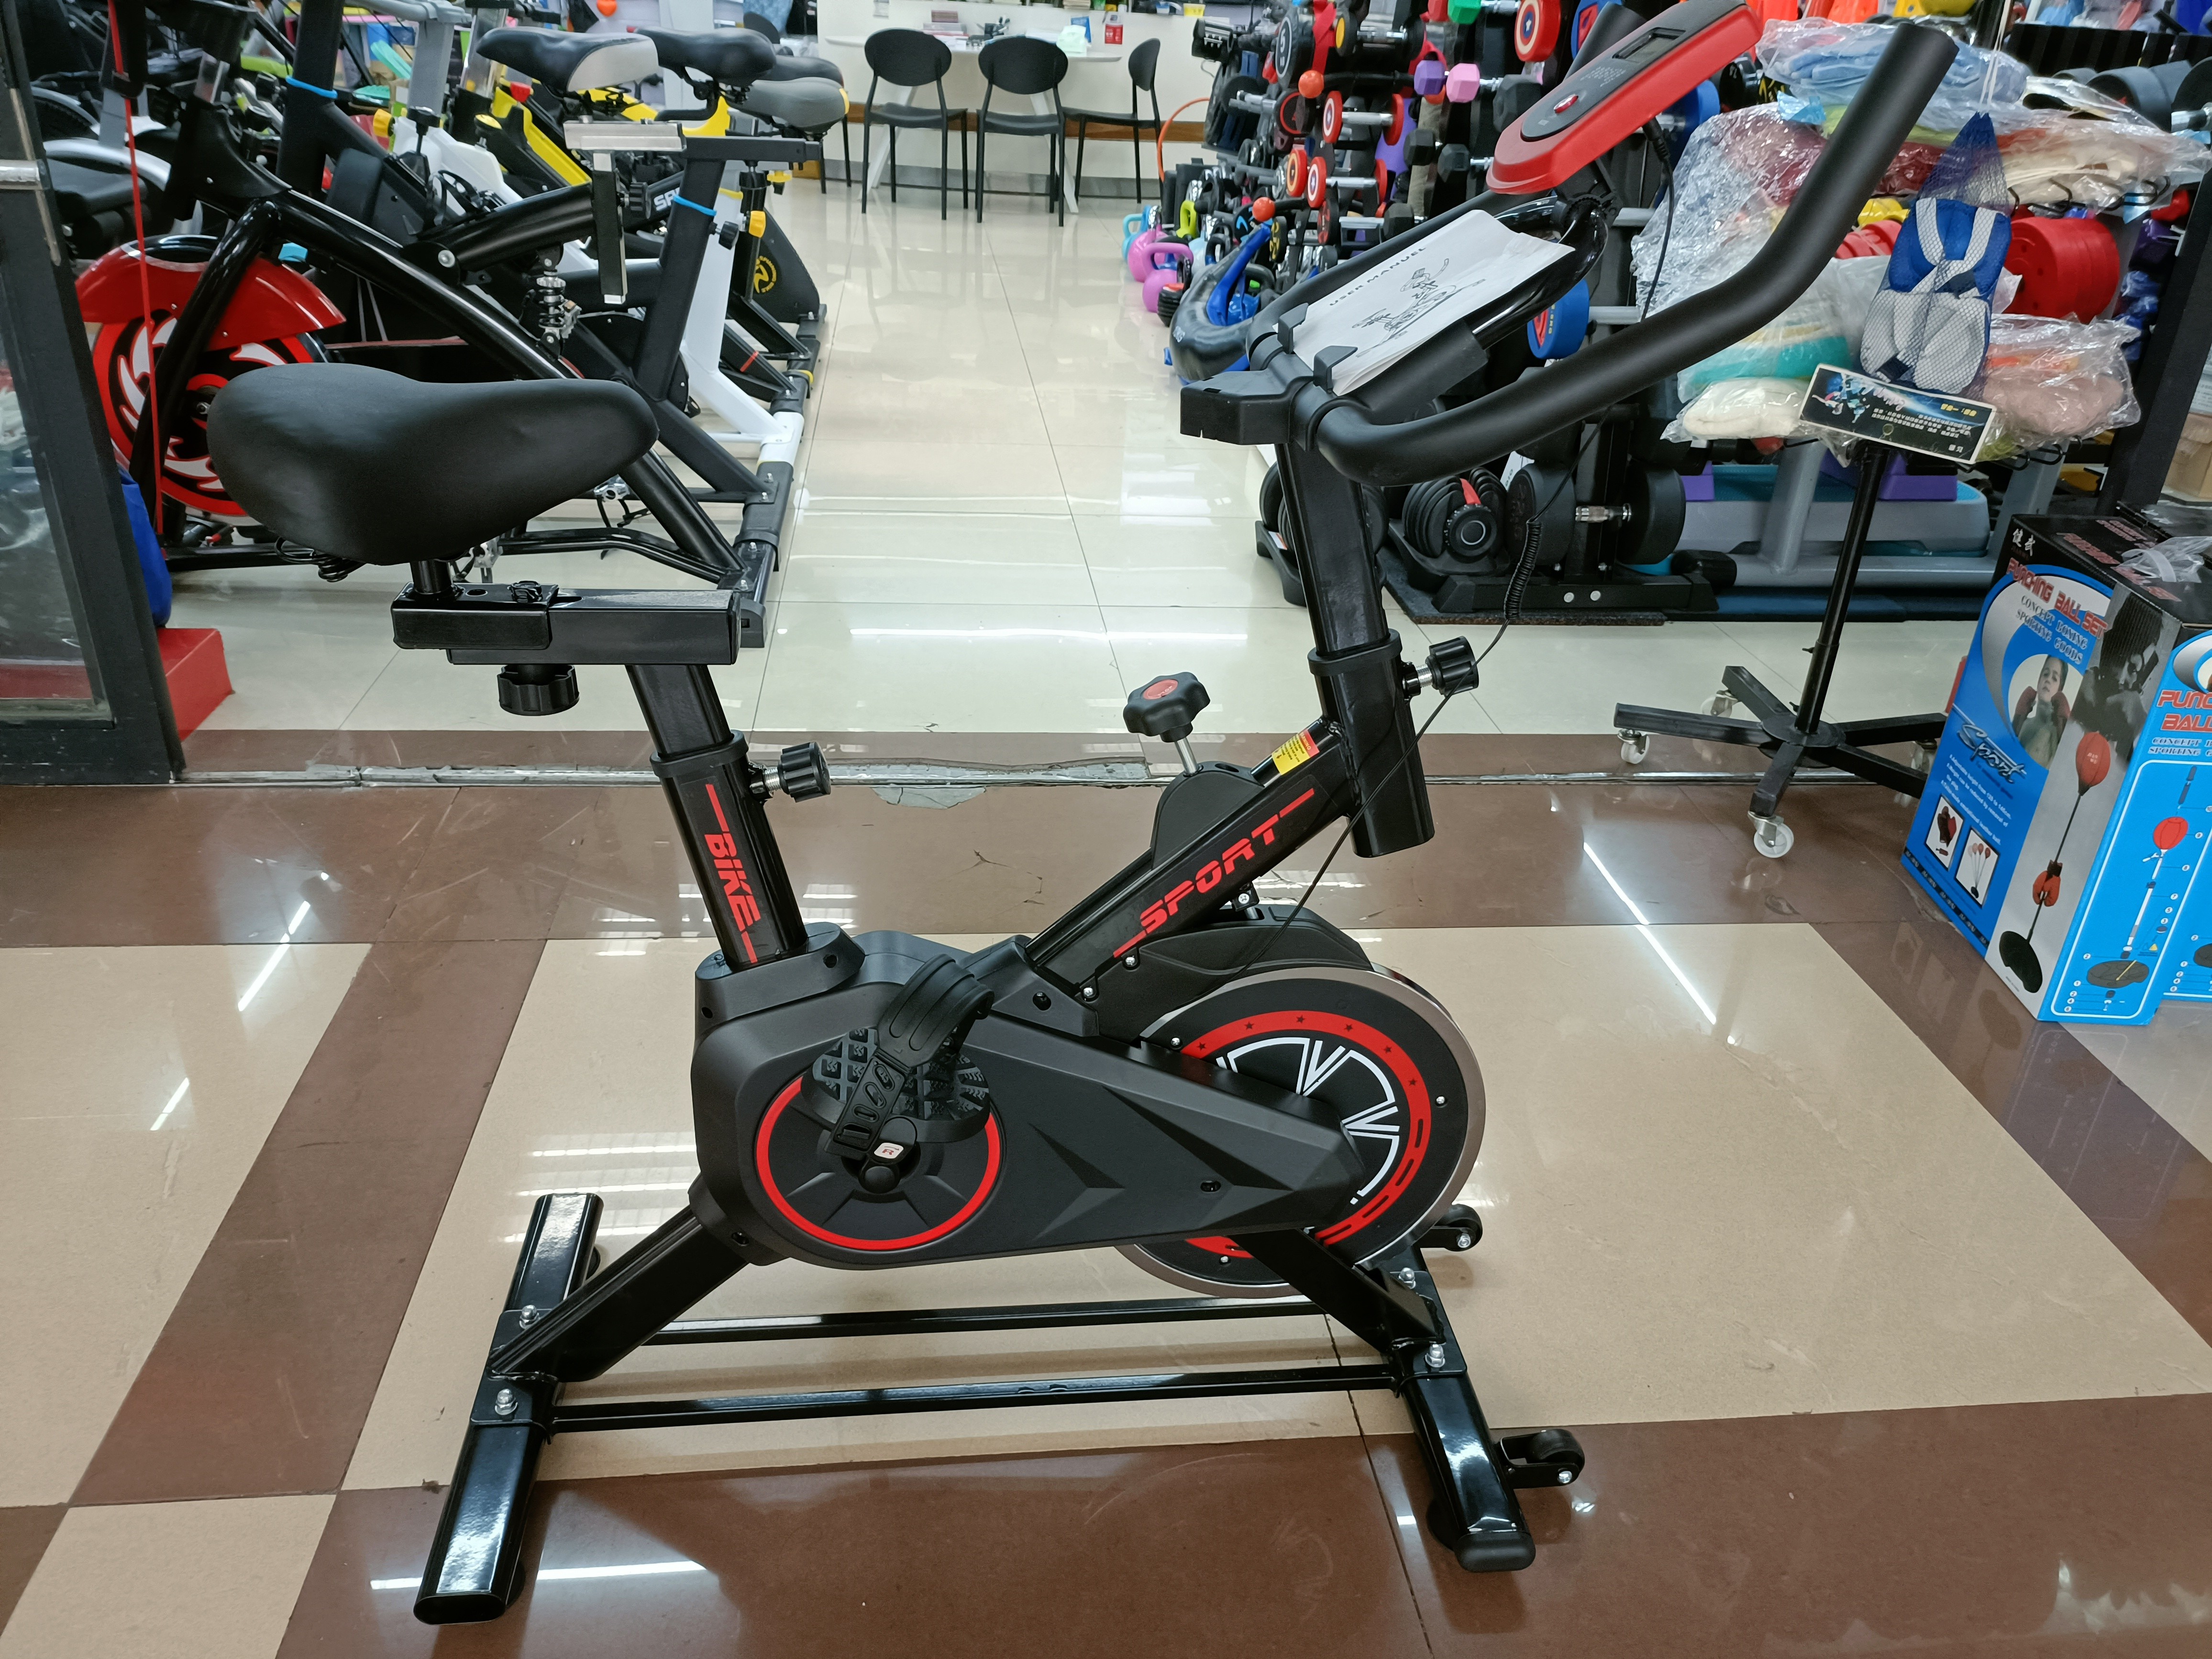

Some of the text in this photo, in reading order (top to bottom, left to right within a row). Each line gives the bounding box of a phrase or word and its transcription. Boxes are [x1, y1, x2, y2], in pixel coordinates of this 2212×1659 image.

[1329, 247, 1426, 306] USER MANUEL
[2006, 557, 2108, 639] PUNCHING BALL SET
[2021, 595, 2089, 650] CONCEPT BOXING
[2015, 608, 2083, 665] SPORTING GOODS
[2148, 746, 2201, 756] SPORTING
[2152, 737, 2202, 747] CONCEPT
[704, 833, 761, 931] BIKE
[1139, 814, 1279, 934] SPORT
